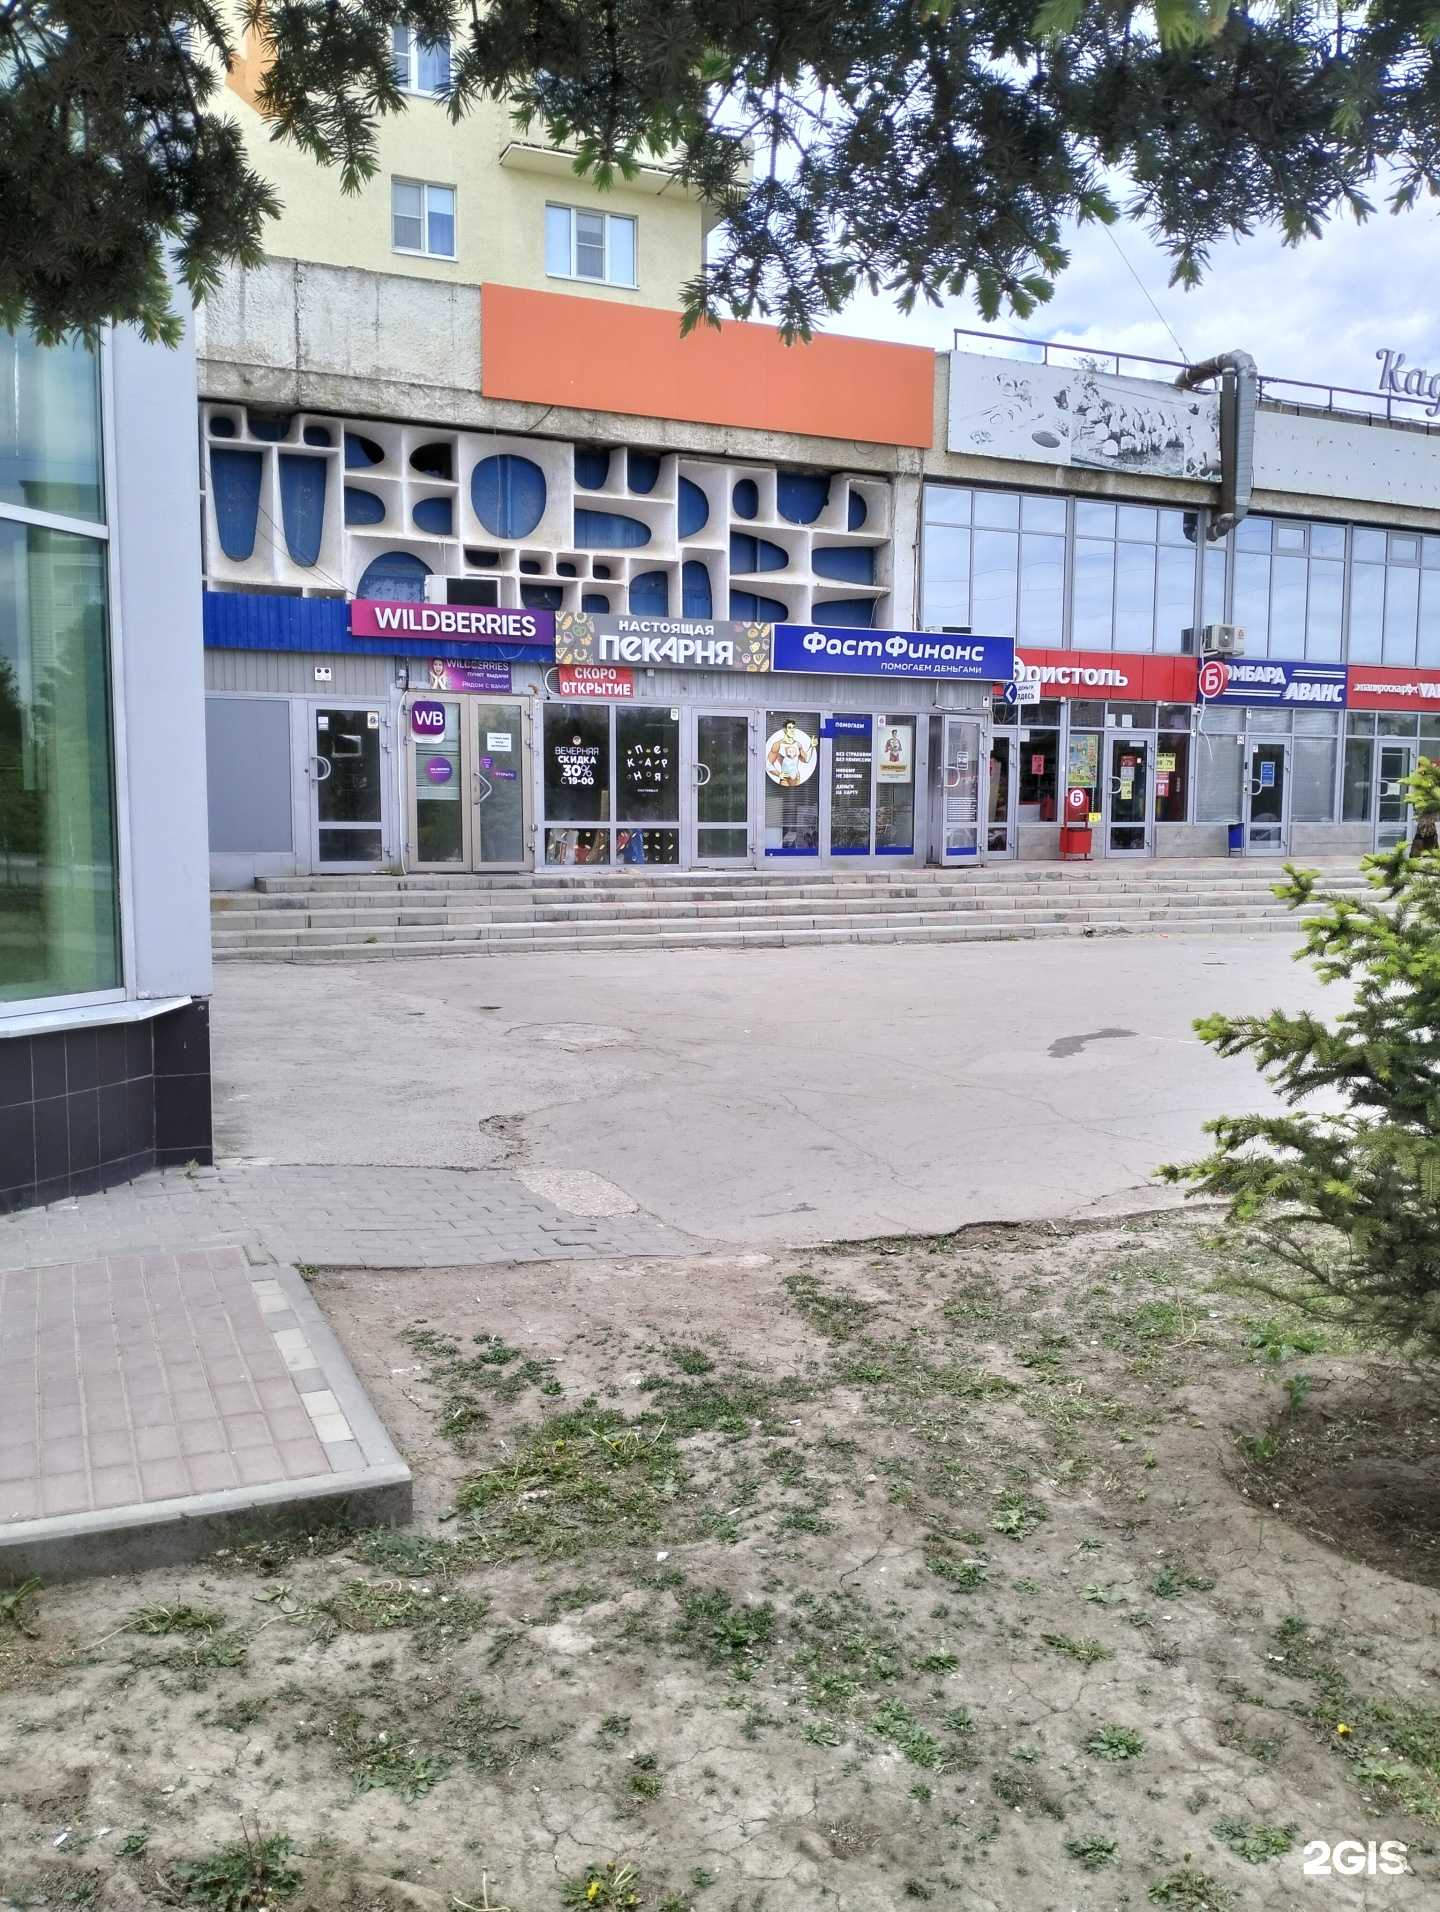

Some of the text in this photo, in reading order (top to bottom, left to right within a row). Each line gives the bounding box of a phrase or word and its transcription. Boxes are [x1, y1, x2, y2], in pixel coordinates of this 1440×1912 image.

[375, 607, 537, 637] WILDBERRIES
[618, 620, 715, 636] НАСТОЯЩАЯ
[803, 632, 985, 662] ФастФинанс
[574, 667, 617, 680] СКОРО
[880, 662, 983, 674] ПОМОГАЕМ ДЕНЬГАМИ
[1205, 668, 1218, 691] Б
[562, 681, 631, 696] ОТКРЫТИЕ
[1281, 682, 1345, 703] АВАНС
[414, 710, 444, 726] WB
[555, 746, 599, 756] ВЕЧЕРНЯЯ
[558, 755, 597, 765] СКИДКА
[562, 764, 593, 777] 30%
[568, 776, 595, 785] 19-00
